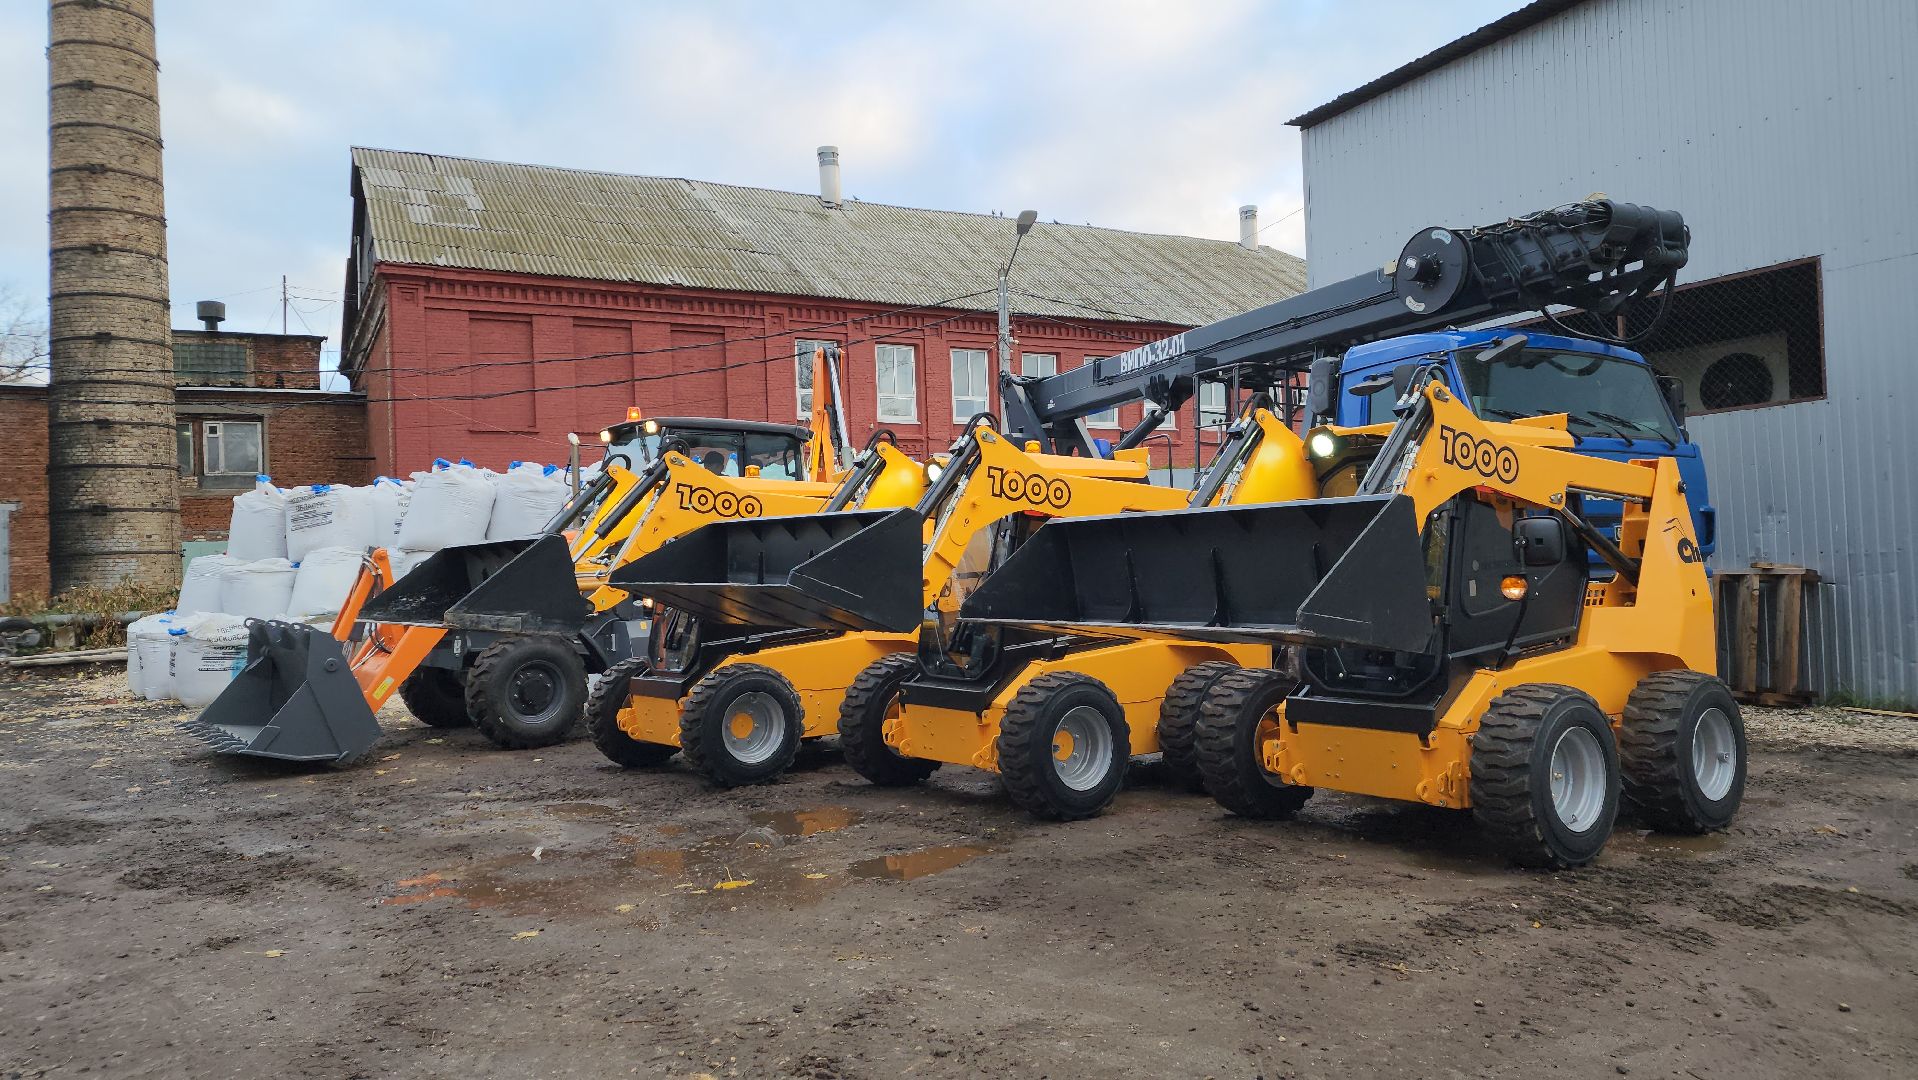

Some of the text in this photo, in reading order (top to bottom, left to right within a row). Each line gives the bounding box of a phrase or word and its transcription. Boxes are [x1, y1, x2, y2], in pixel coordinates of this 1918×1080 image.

[1120, 332, 1186, 374] ВИПО-32-01
[1440, 424, 1519, 484] 1000
[676, 483, 763, 517] 1000
[987, 466, 1072, 509] 1000
